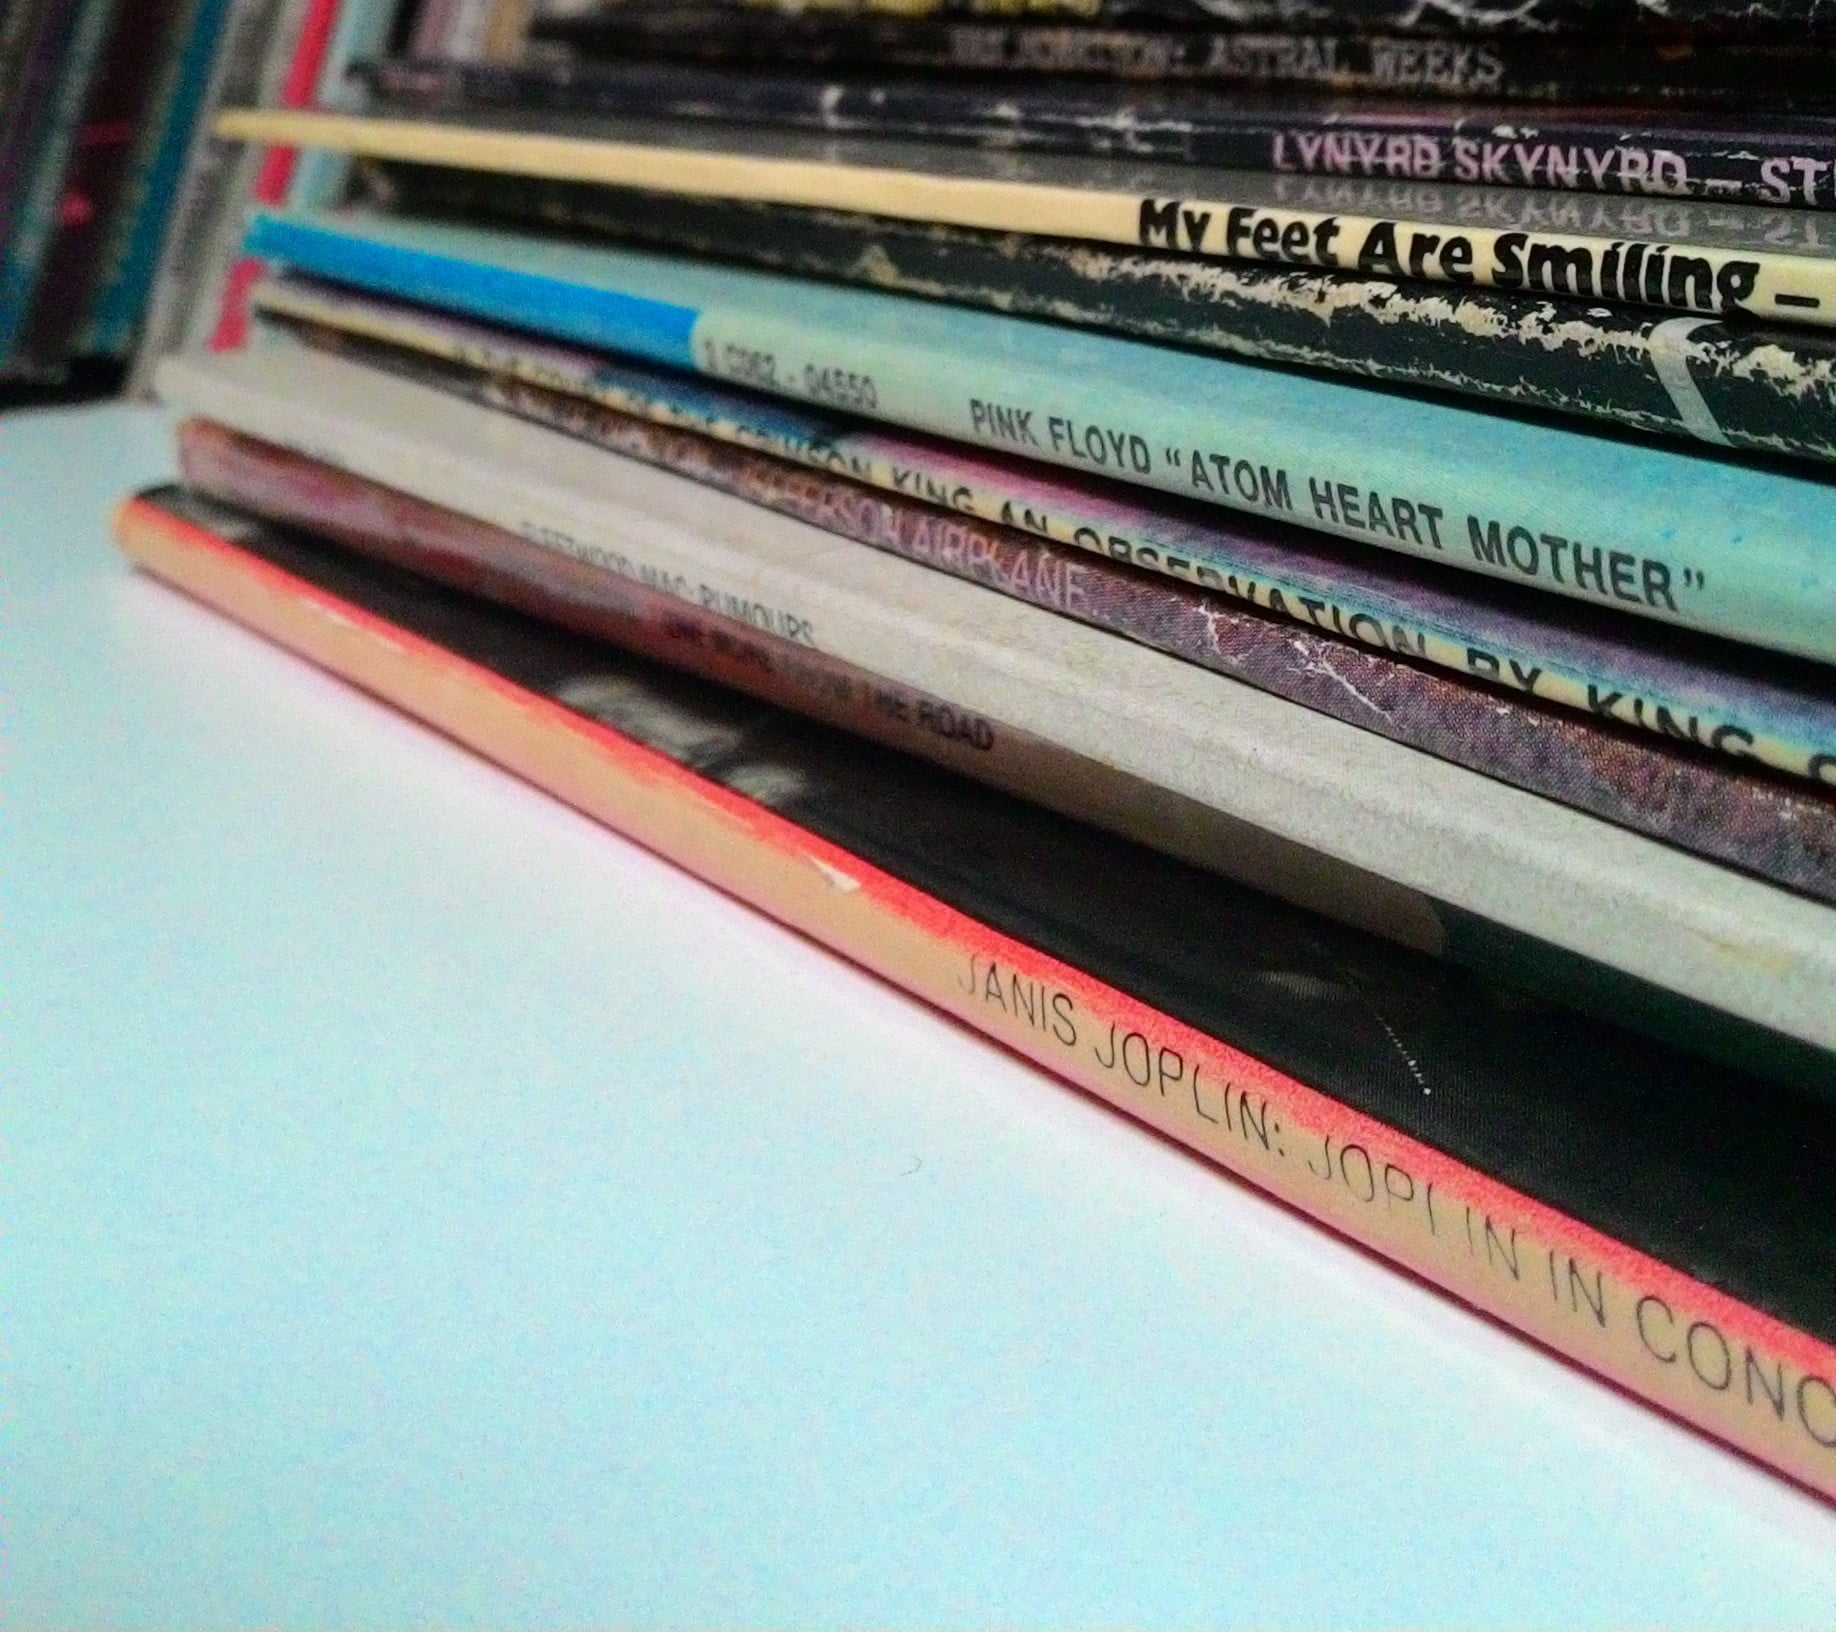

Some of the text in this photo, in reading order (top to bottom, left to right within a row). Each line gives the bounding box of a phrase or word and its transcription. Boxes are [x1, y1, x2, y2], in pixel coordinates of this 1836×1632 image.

[1207, 33, 1345, 80] ASTRAL
[1370, 35, 1505, 90] WEEKS
[1270, 128, 1442, 180] LYNYRD
[1452, 137, 1692, 196] SKYNYRD
[1758, 156, 1836, 206] ST
[1139, 198, 1212, 253] My
[1226, 206, 1342, 268] Feet
[1358, 221, 1476, 285] Are
[1491, 232, 1761, 318] Smiling
[968, 397, 1040, 447] PINK
[1048, 416, 1152, 475] FLOYD
[1308, 475, 1445, 550] HEART
[916, 698, 995, 751] ROAD
[957, 953, 1078, 1048] JANIS
[1094, 1020, 1286, 1158] JOPLIN:
[1307, 1133, 1522, 1282] JOPLIN
[1548, 1249, 1607, 1330] IN
